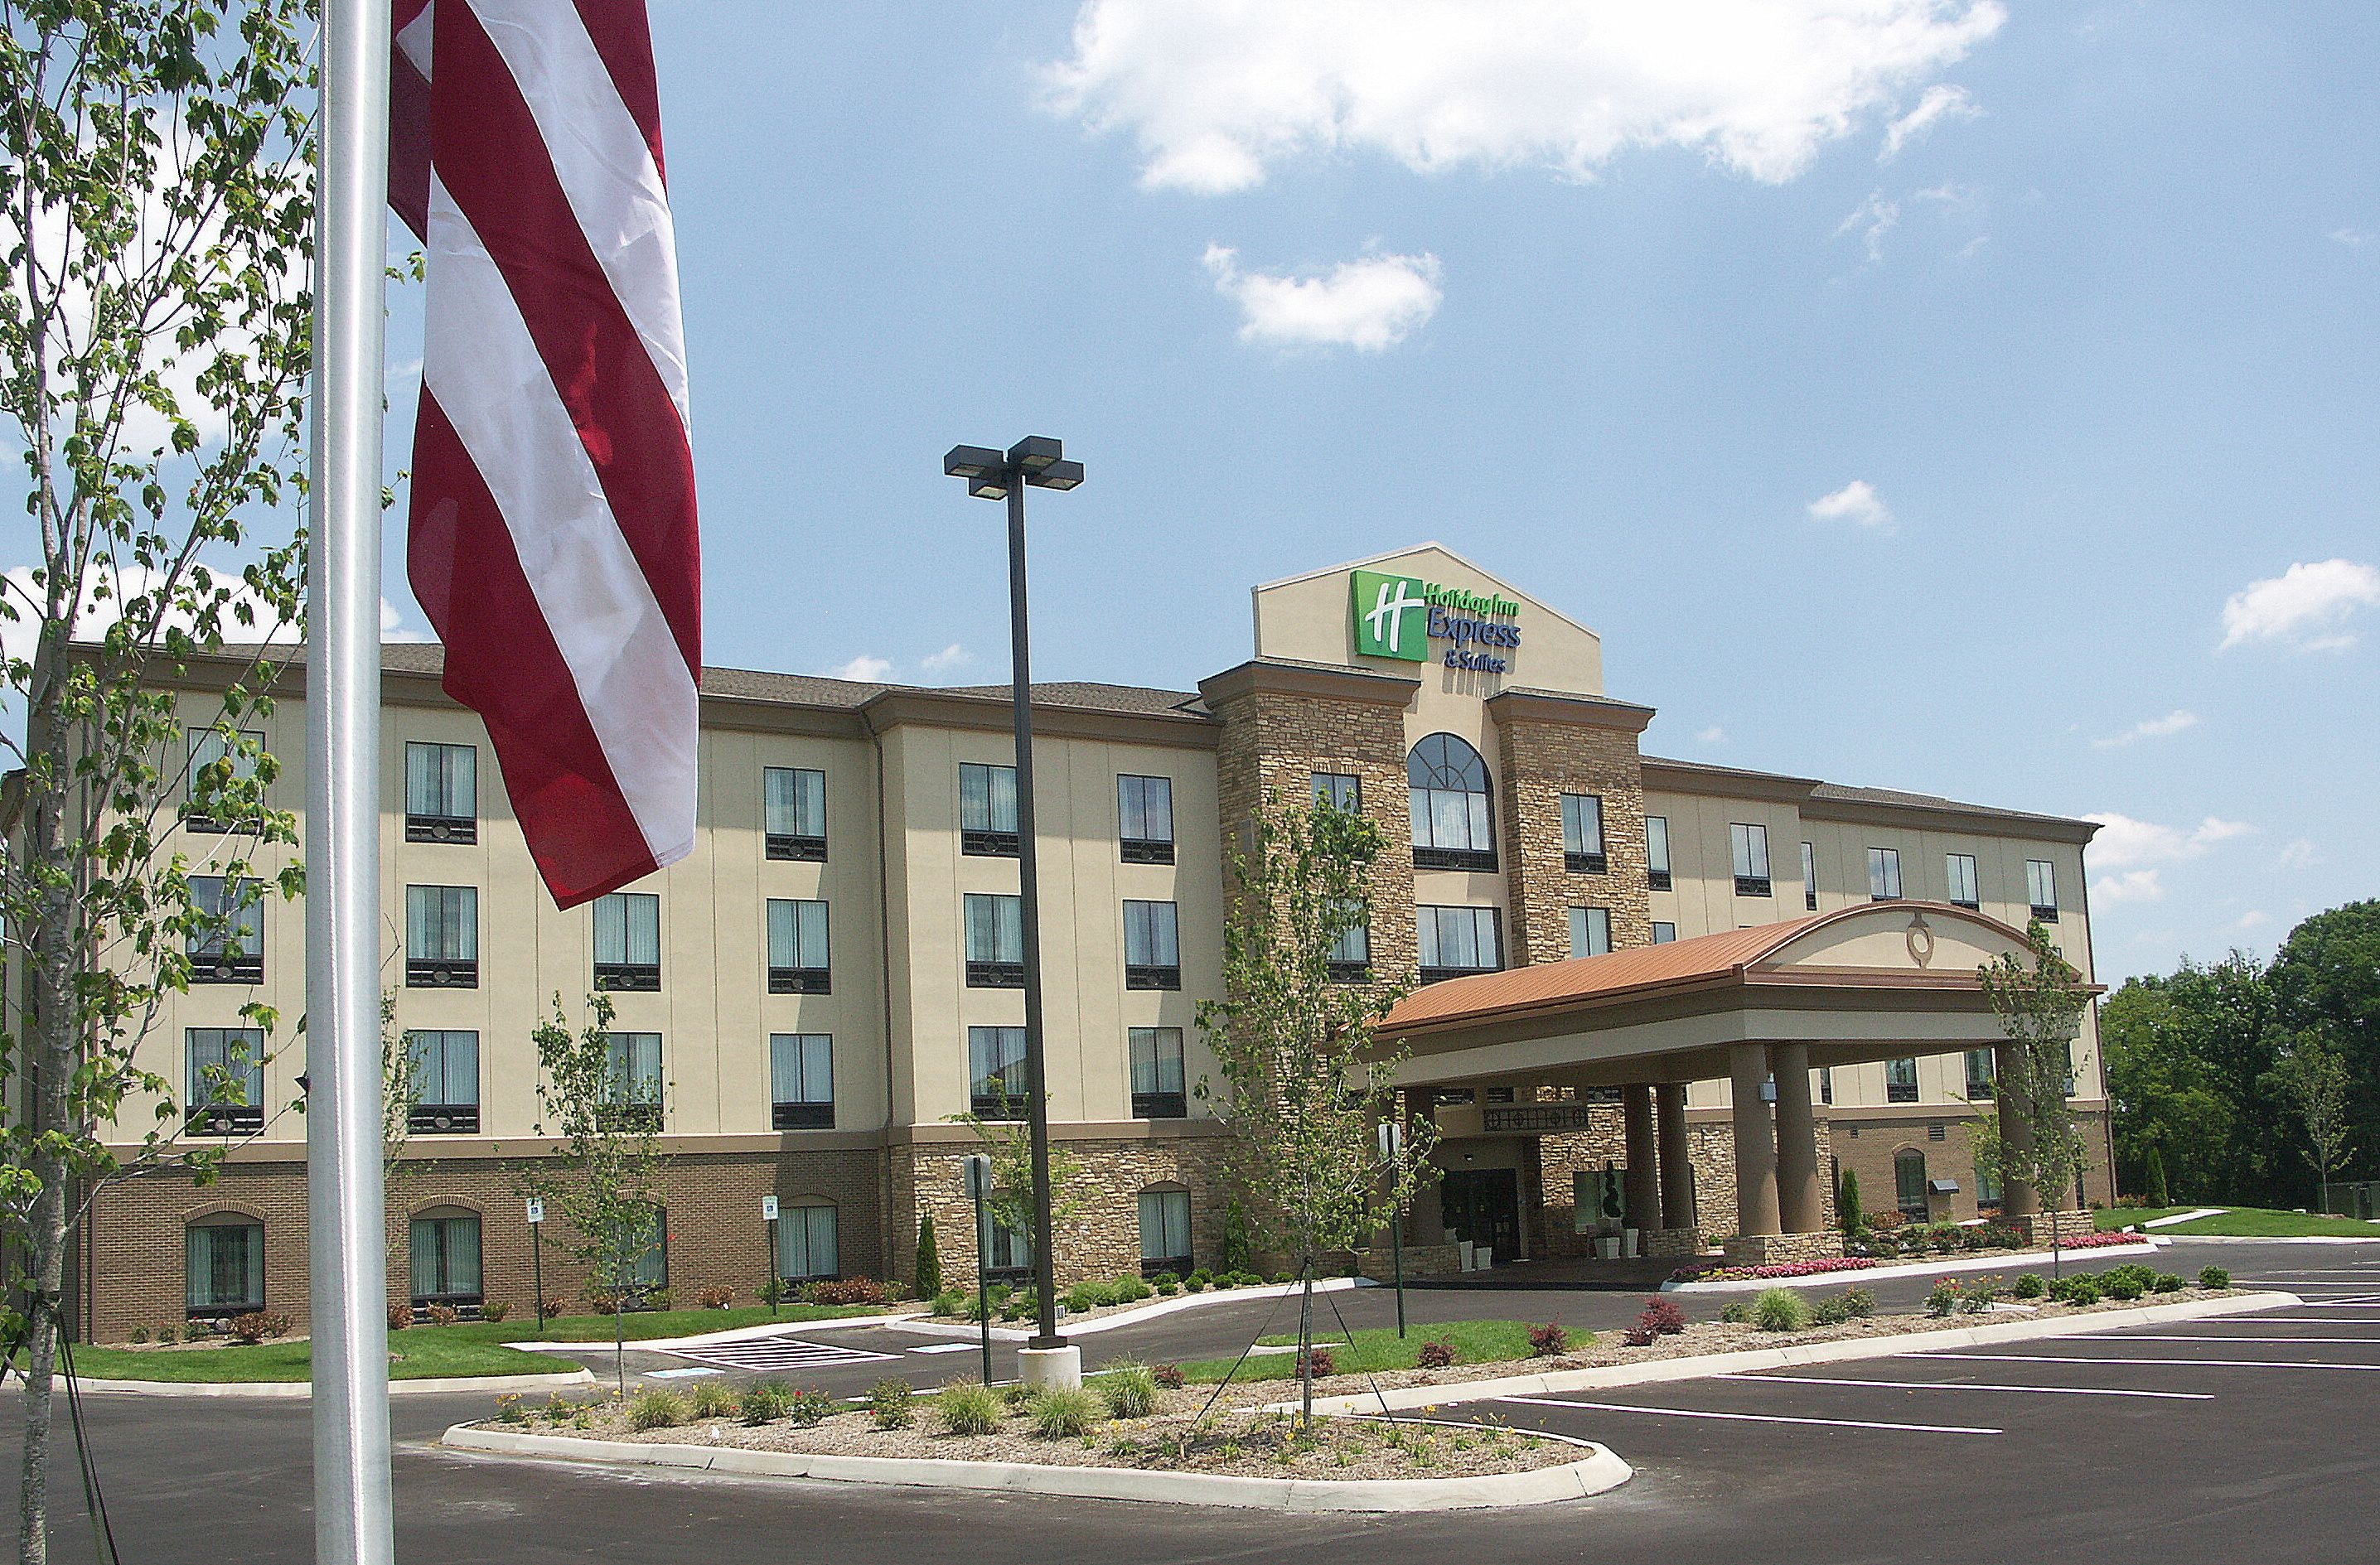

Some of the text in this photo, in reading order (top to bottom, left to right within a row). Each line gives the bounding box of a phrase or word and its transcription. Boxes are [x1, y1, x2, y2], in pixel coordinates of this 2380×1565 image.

[1425, 583, 1521, 617] Holiday Inn
[1428, 607, 1521, 648] Express
[1444, 650, 1458, 668] &
